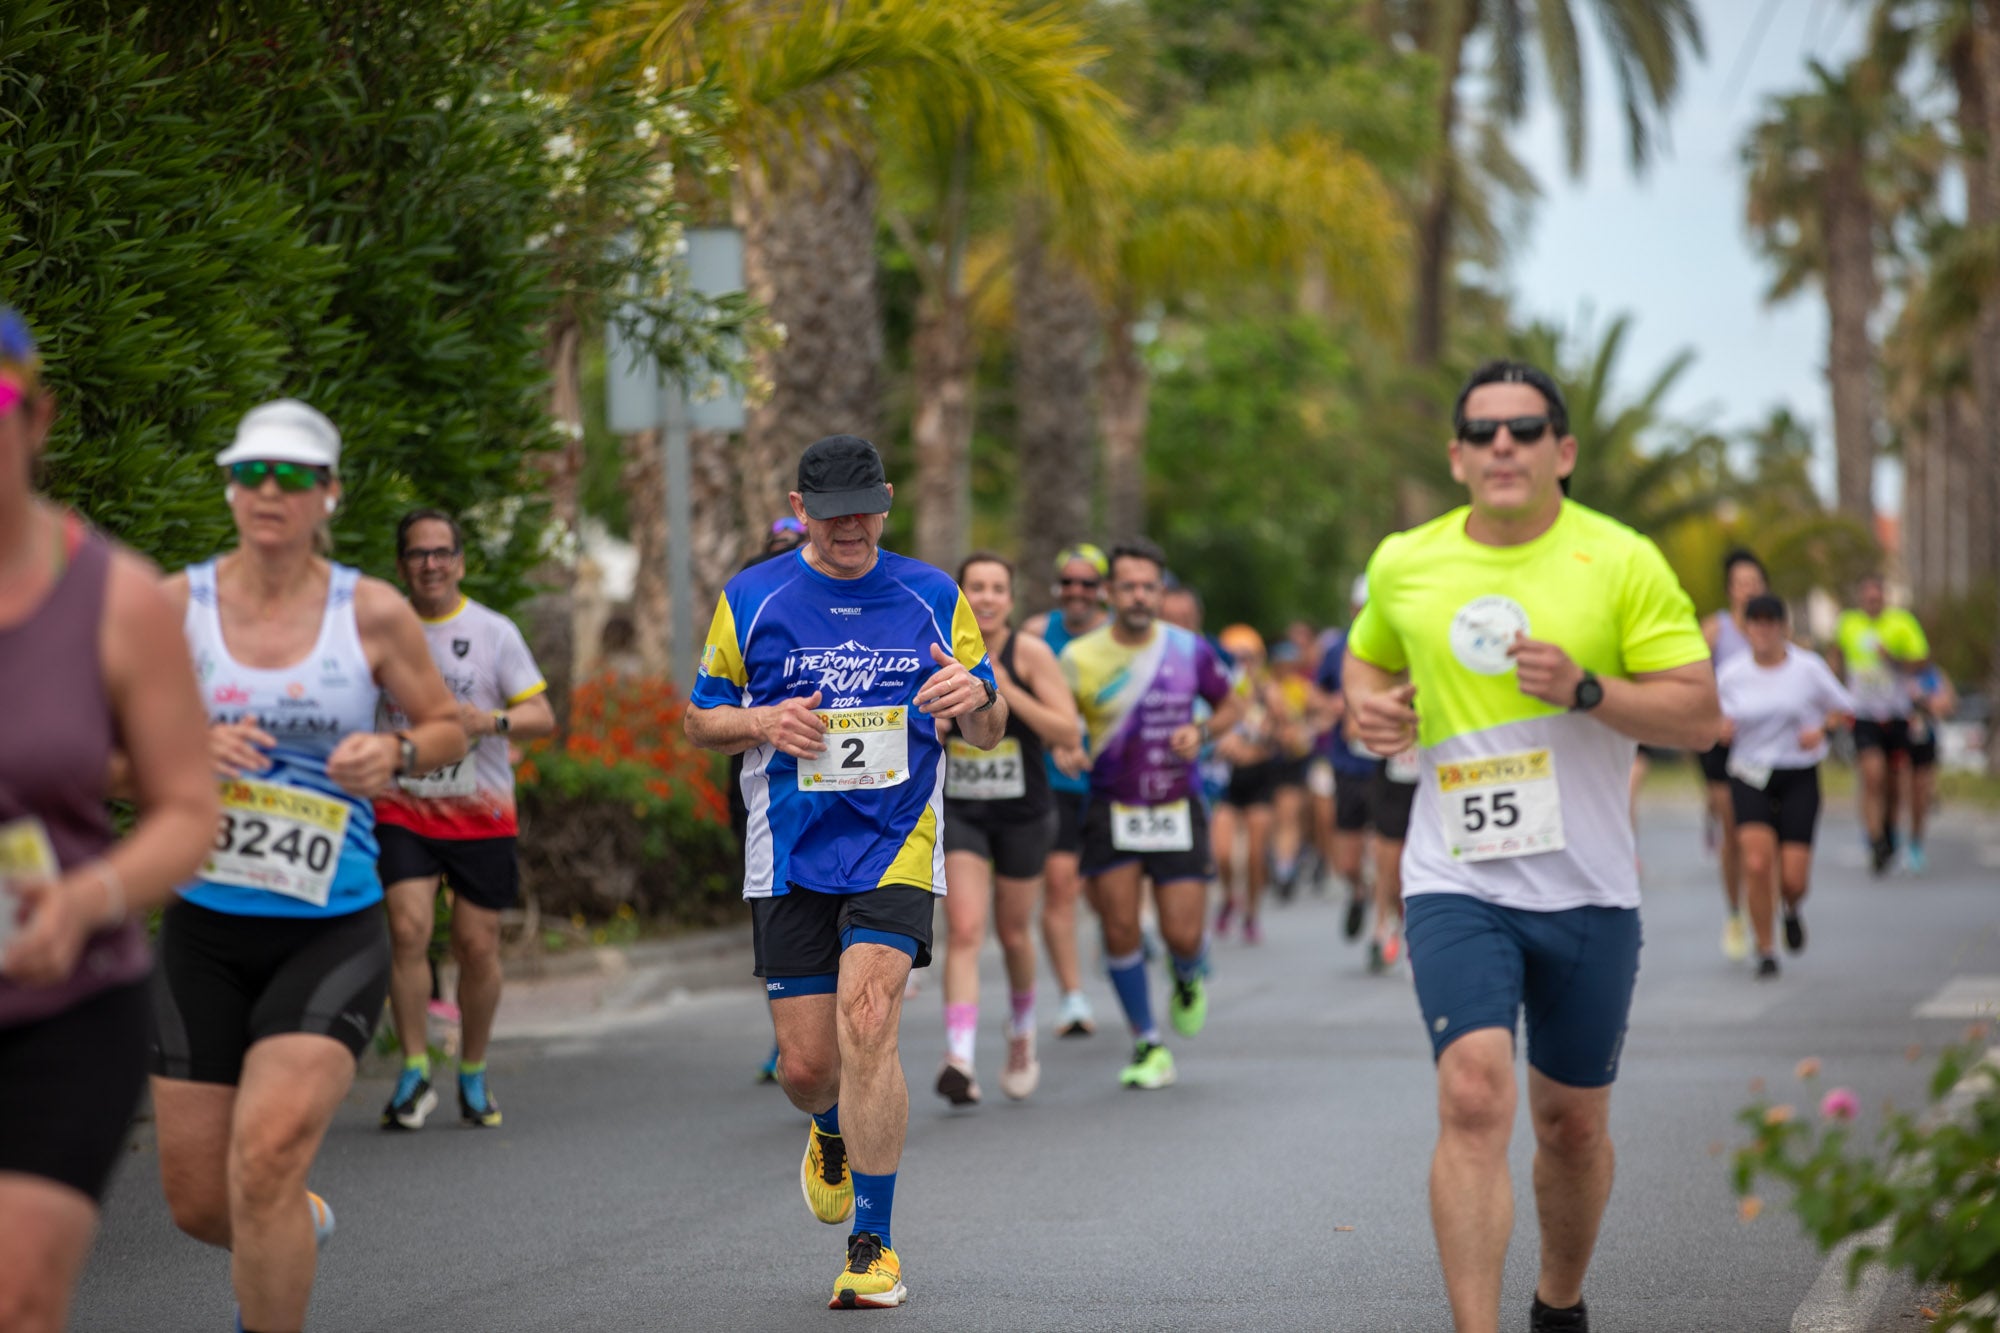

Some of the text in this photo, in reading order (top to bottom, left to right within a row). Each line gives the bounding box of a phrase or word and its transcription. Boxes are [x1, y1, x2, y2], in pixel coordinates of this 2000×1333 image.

[783, 651, 920, 678] II PEÑONCILLOS
[816, 667, 877, 695] RUN
[831, 696, 863, 708] 2024
[841, 738, 865, 768] 2
[1464, 791, 1520, 833] 55
